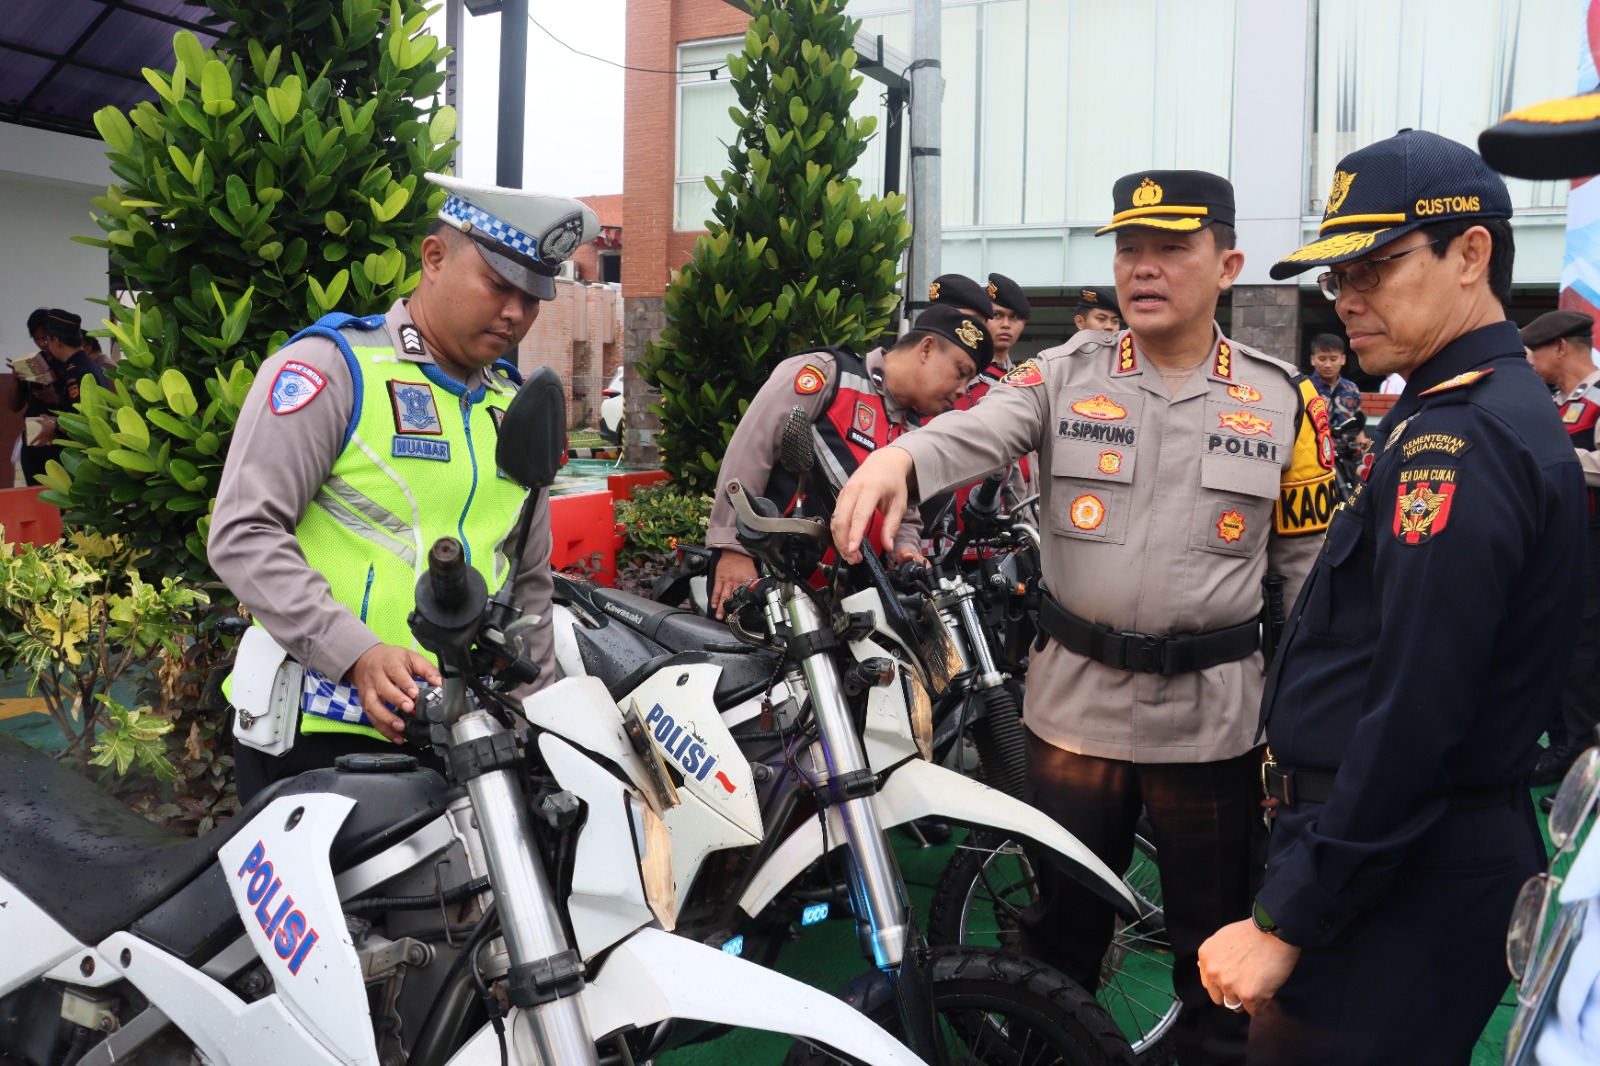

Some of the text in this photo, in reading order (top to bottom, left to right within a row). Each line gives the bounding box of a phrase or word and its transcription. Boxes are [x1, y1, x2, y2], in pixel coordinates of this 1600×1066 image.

[1415, 195, 1481, 216] CUSTOMS
[1058, 420, 1135, 445] R.SIPAYUNG
[1402, 434, 1466, 452] KEMENTERIAN
[396, 439, 447, 457] MUAMAR
[1208, 435, 1277, 461] POLRI
[1406, 441, 1458, 458] KEUANGAN
[1413, 469, 1429, 481] DAN
[1430, 469, 1456, 483] CUKAI
[604, 601, 643, 625] Kawasaki
[645, 702, 717, 781] POLISI
[237, 839, 319, 977] POLISI
